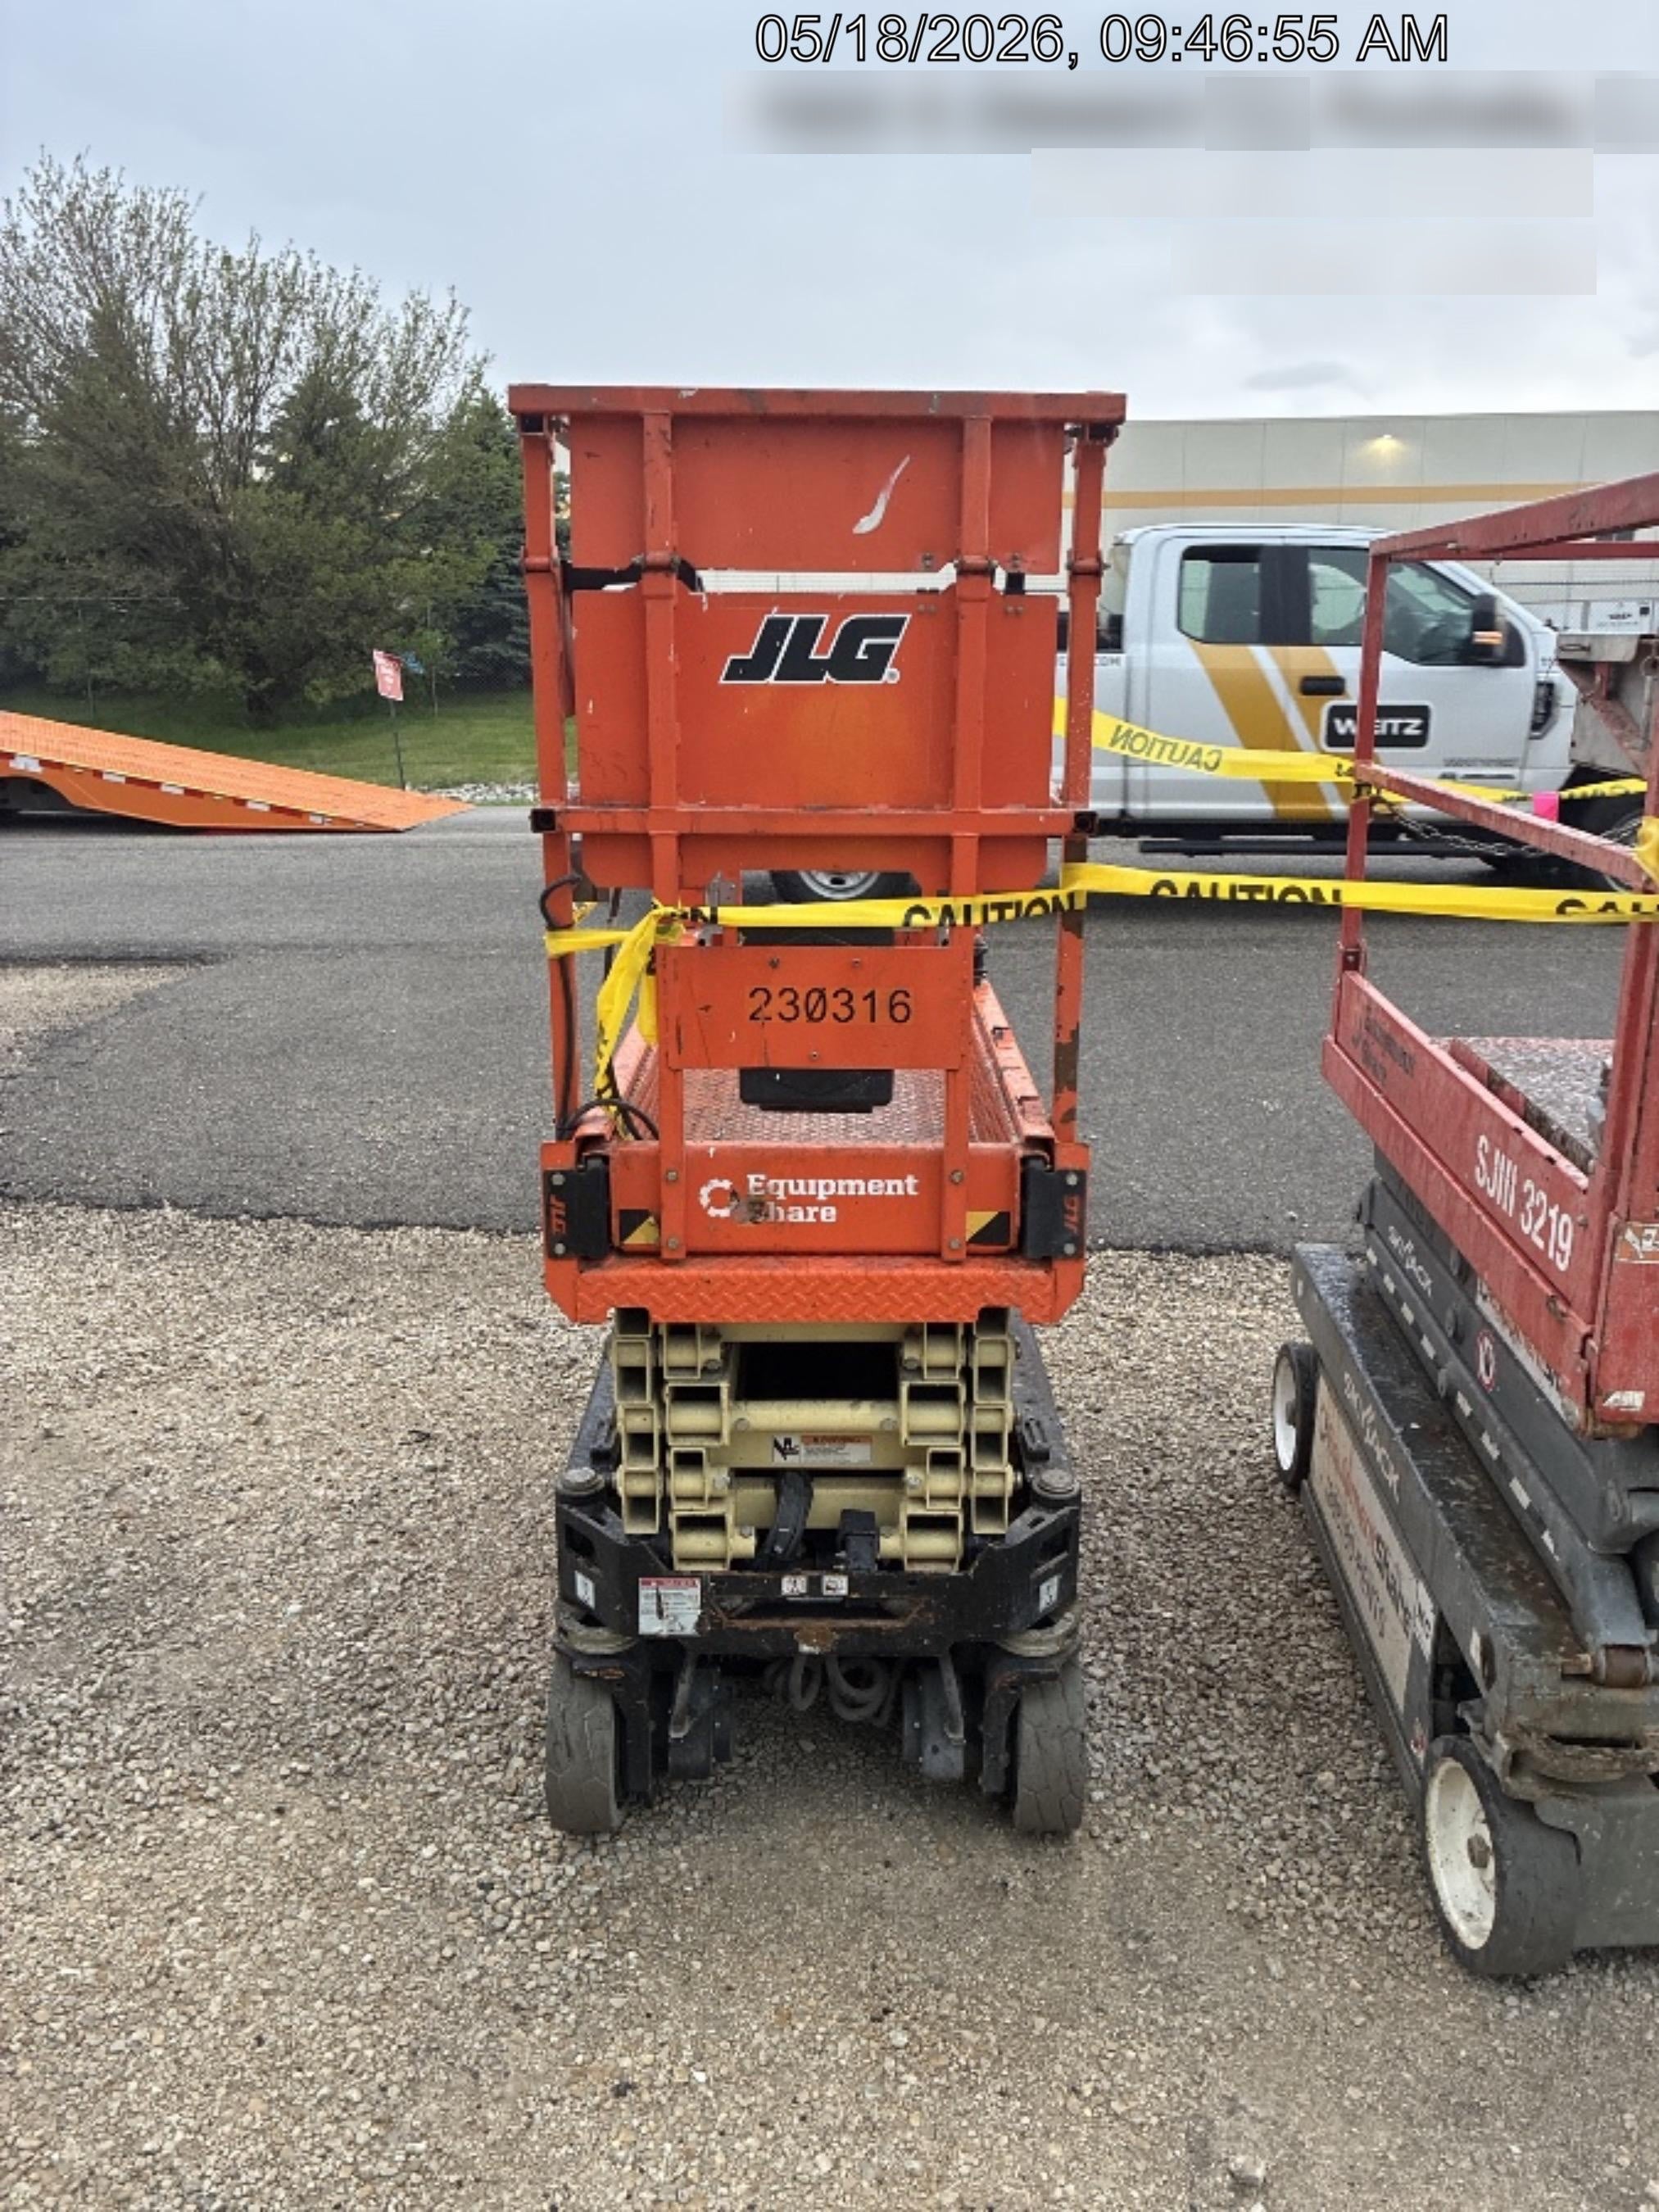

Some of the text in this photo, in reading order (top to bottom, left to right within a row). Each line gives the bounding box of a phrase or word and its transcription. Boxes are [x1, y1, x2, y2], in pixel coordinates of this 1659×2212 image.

[719, 614, 911, 684] JLG
[749, 986, 912, 1023] 230316
[746, 1173, 919, 1200] Equipment
[749, 1200, 837, 1222] hare
[1521, 1179, 1573, 1271] 3219
